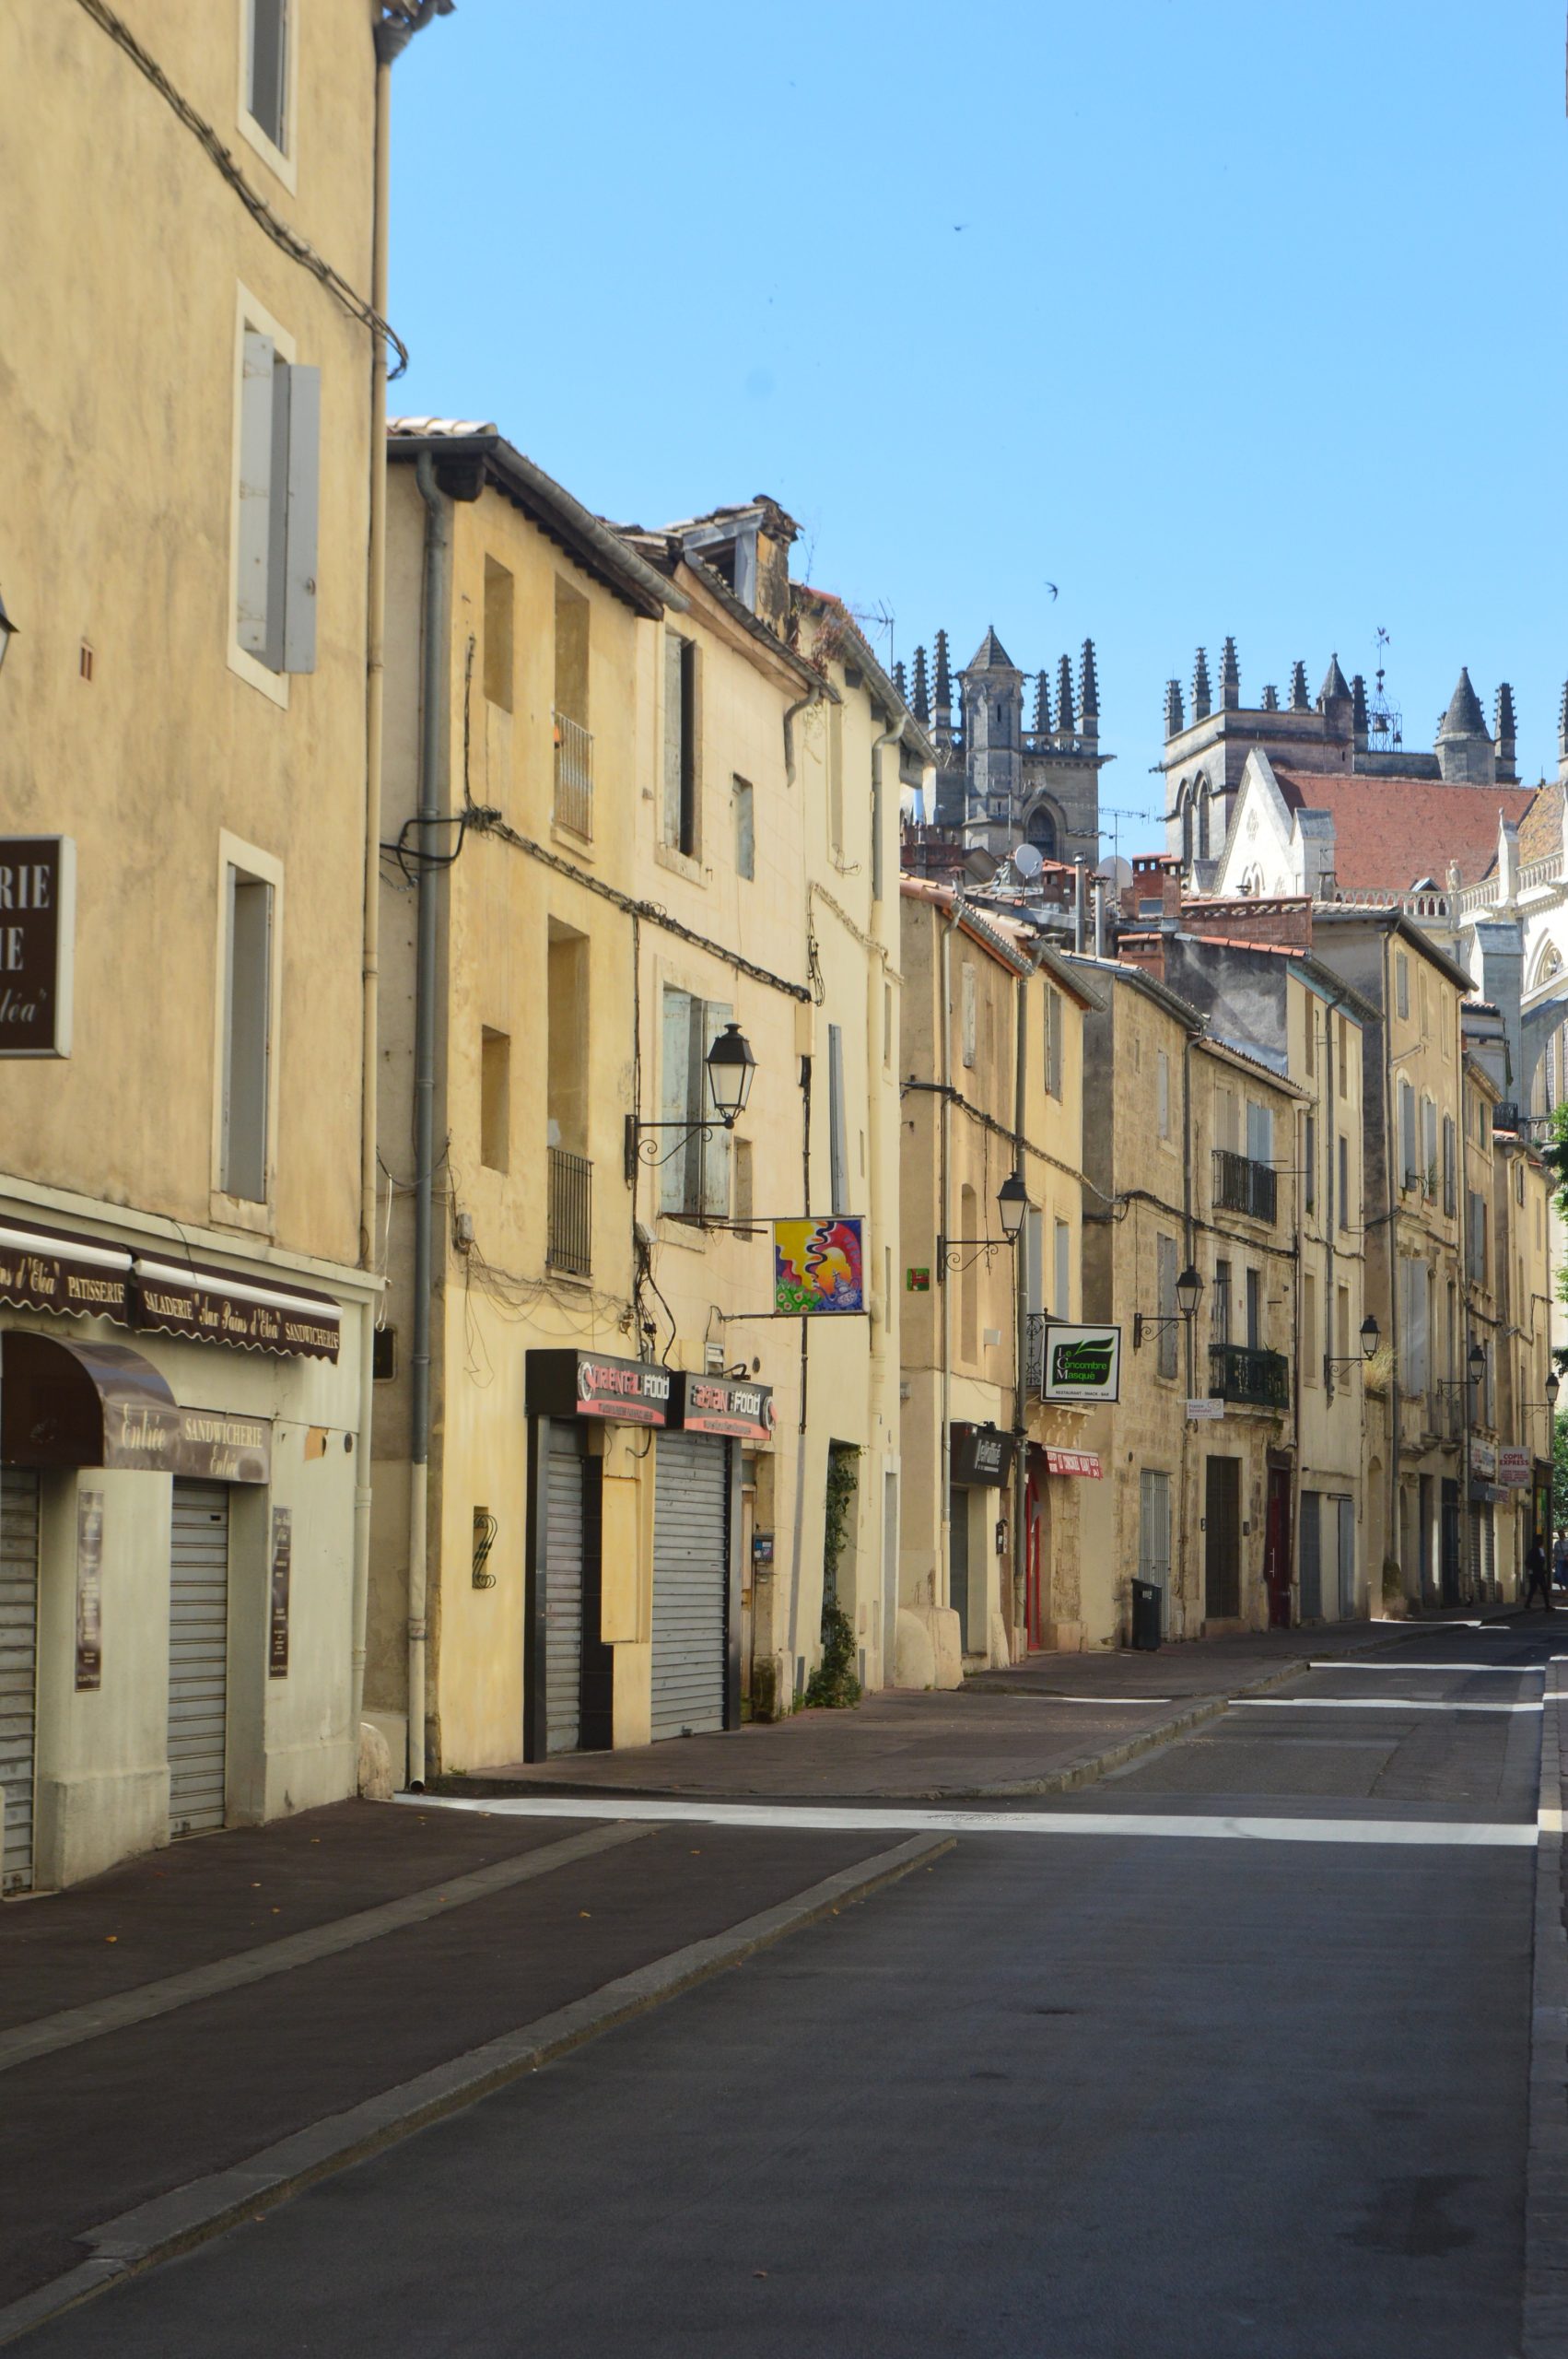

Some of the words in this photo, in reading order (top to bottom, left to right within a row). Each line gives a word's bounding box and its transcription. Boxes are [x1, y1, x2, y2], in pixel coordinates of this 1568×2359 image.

[67, 1275, 125, 1303] PATISSERIE
[144, 1290, 193, 1320] SALADERIE
[285, 1322, 339, 1350] SANDWICHERIE
[1058, 1347, 1071, 1357] Le
[1057, 1357, 1107, 1370] Concombre
[1057, 1369, 1095, 1381] Masqué
[185, 1418, 263, 1449] SANDWICHERIE
